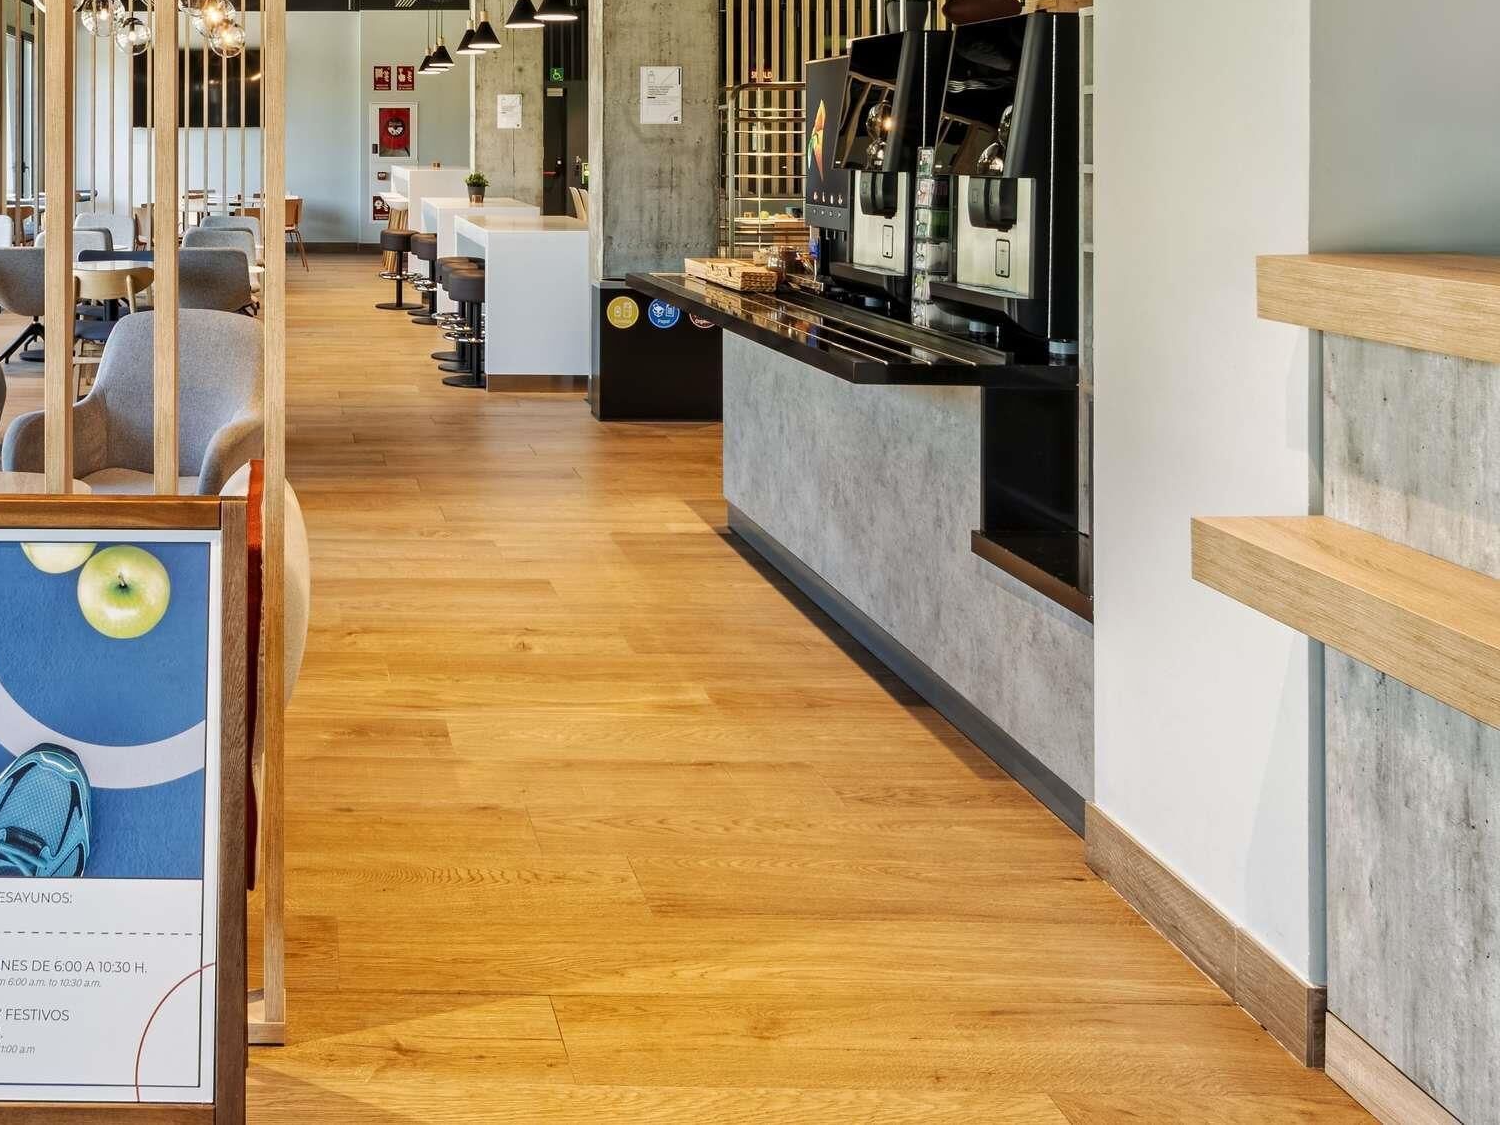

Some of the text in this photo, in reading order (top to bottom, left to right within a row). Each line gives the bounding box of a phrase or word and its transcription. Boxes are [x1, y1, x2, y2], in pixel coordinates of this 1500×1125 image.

[32, 960, 50, 972] DE
[54, 960, 82, 972] 6:00
[85, 961, 95, 972] A
[99, 961, 131, 973] 10:30
[135, 962, 148, 974] H.
[49, 978, 57, 987] to
[60, 978, 82, 987] 10:30
[5, 1008, 70, 1021] FESTIVOS
